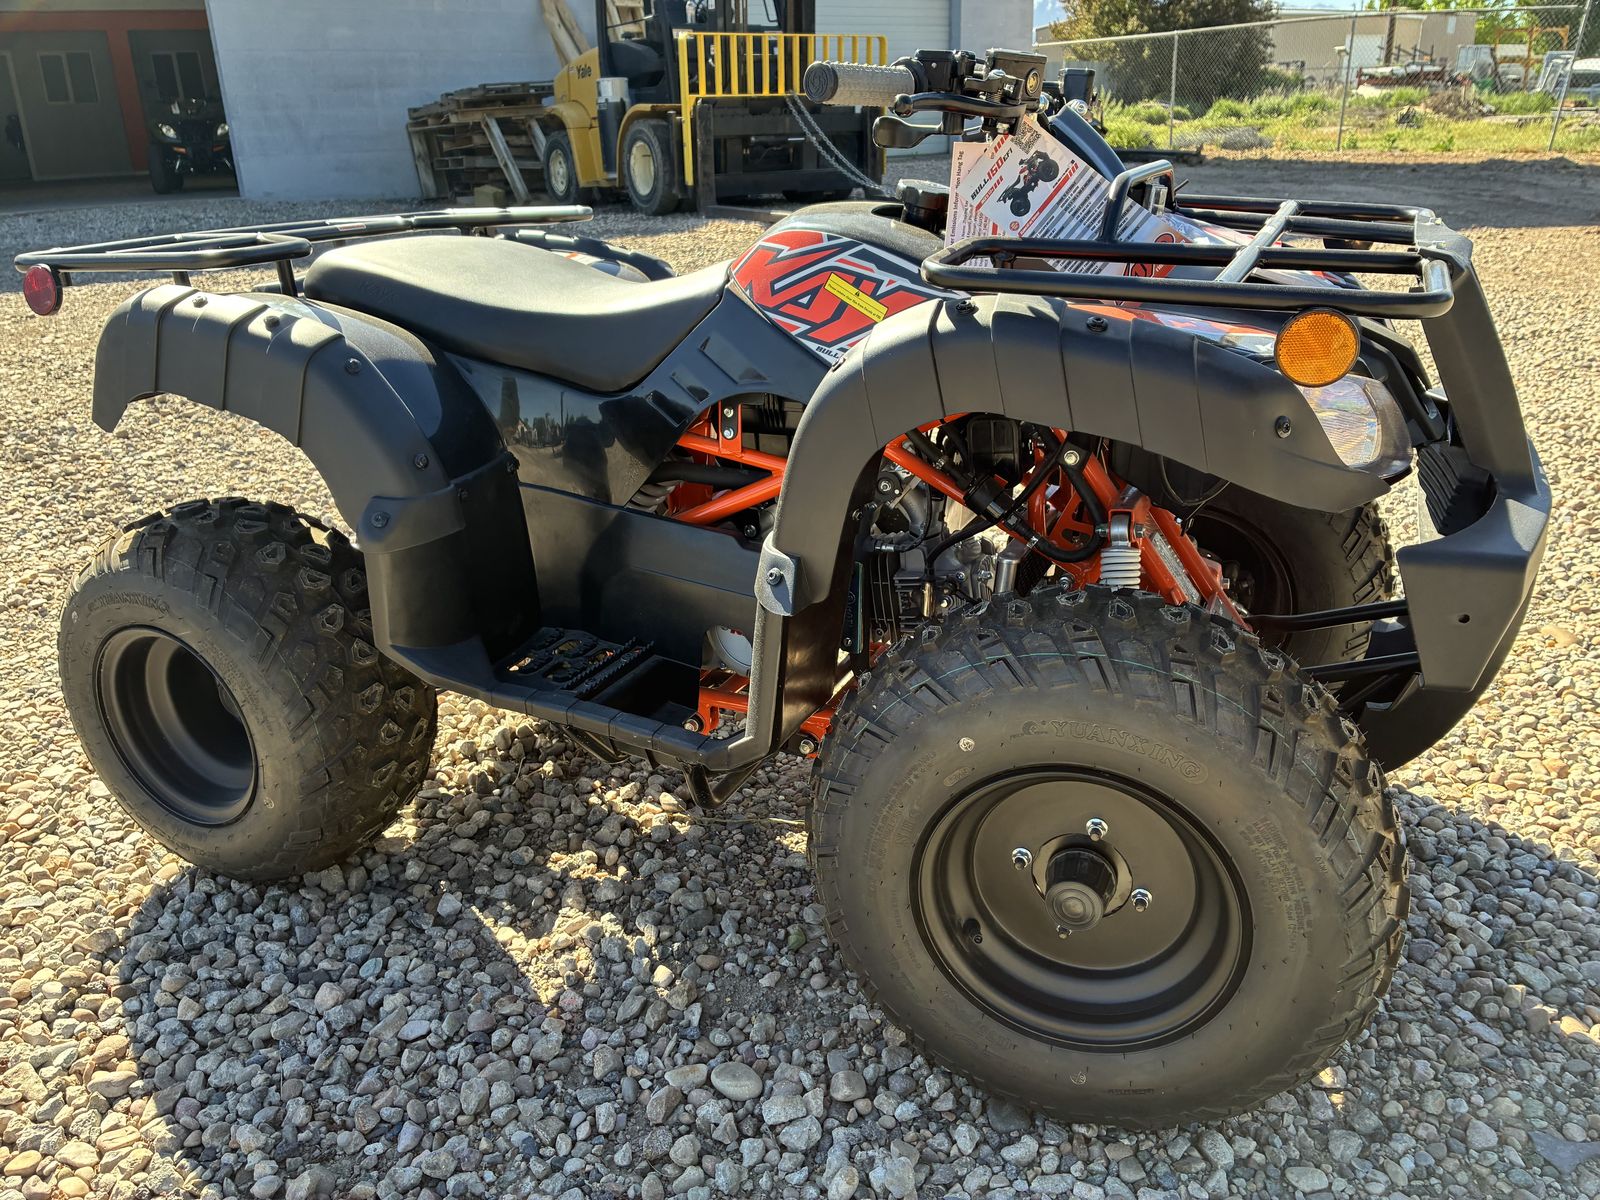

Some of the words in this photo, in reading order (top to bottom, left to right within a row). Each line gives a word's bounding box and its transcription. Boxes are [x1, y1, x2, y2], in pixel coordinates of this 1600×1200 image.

[575, 63, 592, 79] Yale
[814, 345, 841, 360] BULL
[1049, 720, 1202, 782] YUANXING
